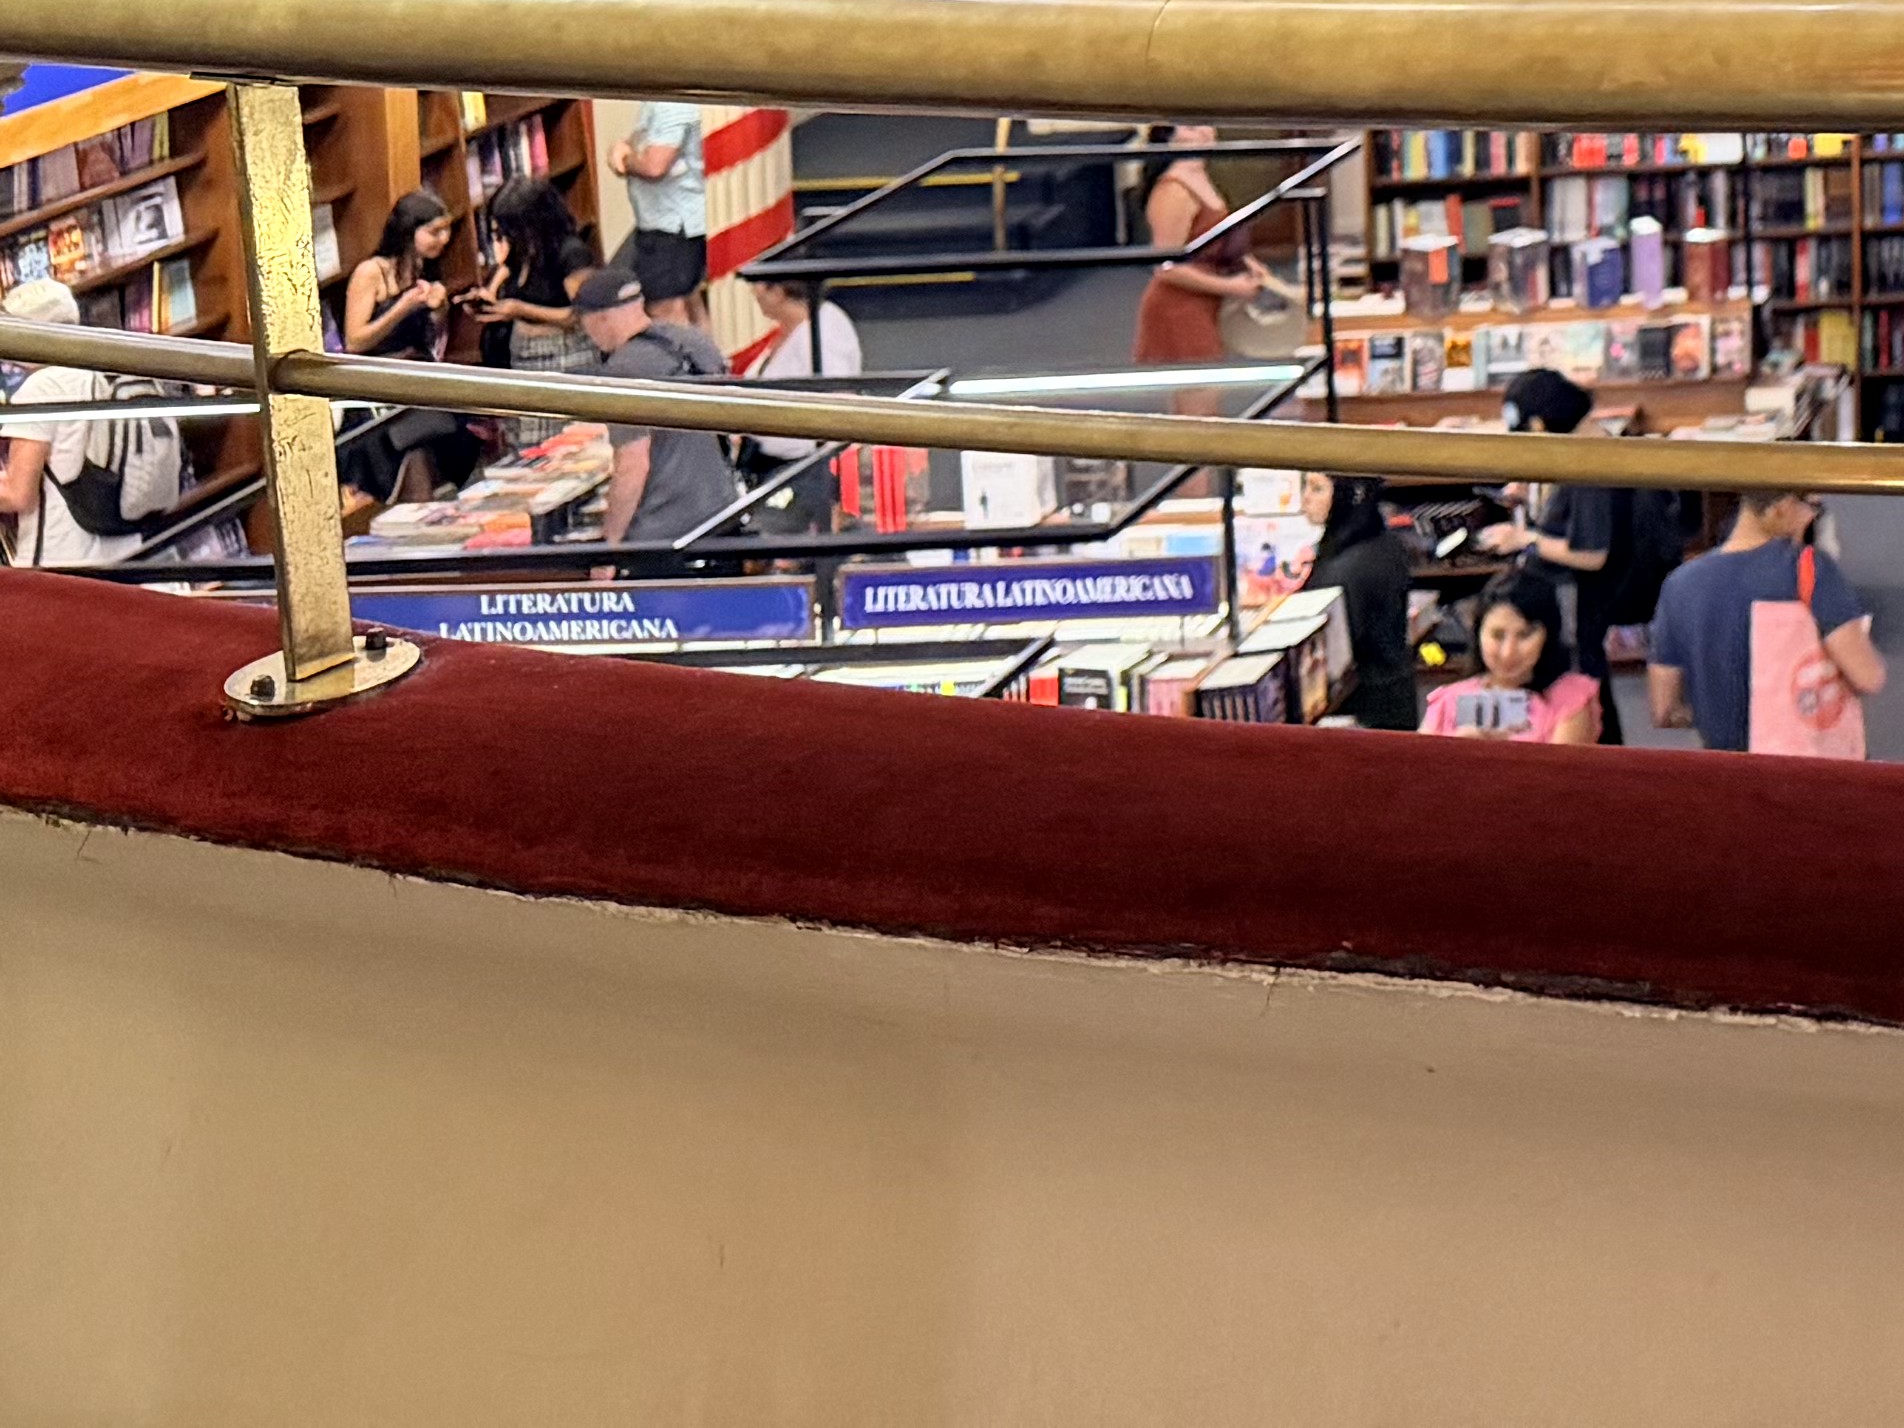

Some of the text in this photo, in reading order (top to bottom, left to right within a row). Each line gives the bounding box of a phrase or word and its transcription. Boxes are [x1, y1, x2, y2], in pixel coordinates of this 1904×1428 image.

[480, 591, 636, 615] LITERATURA
[863, 573, 1194, 613] LITERATURA LATINOAMERICANA
[438, 617, 680, 644] LATINOAMERICANA
